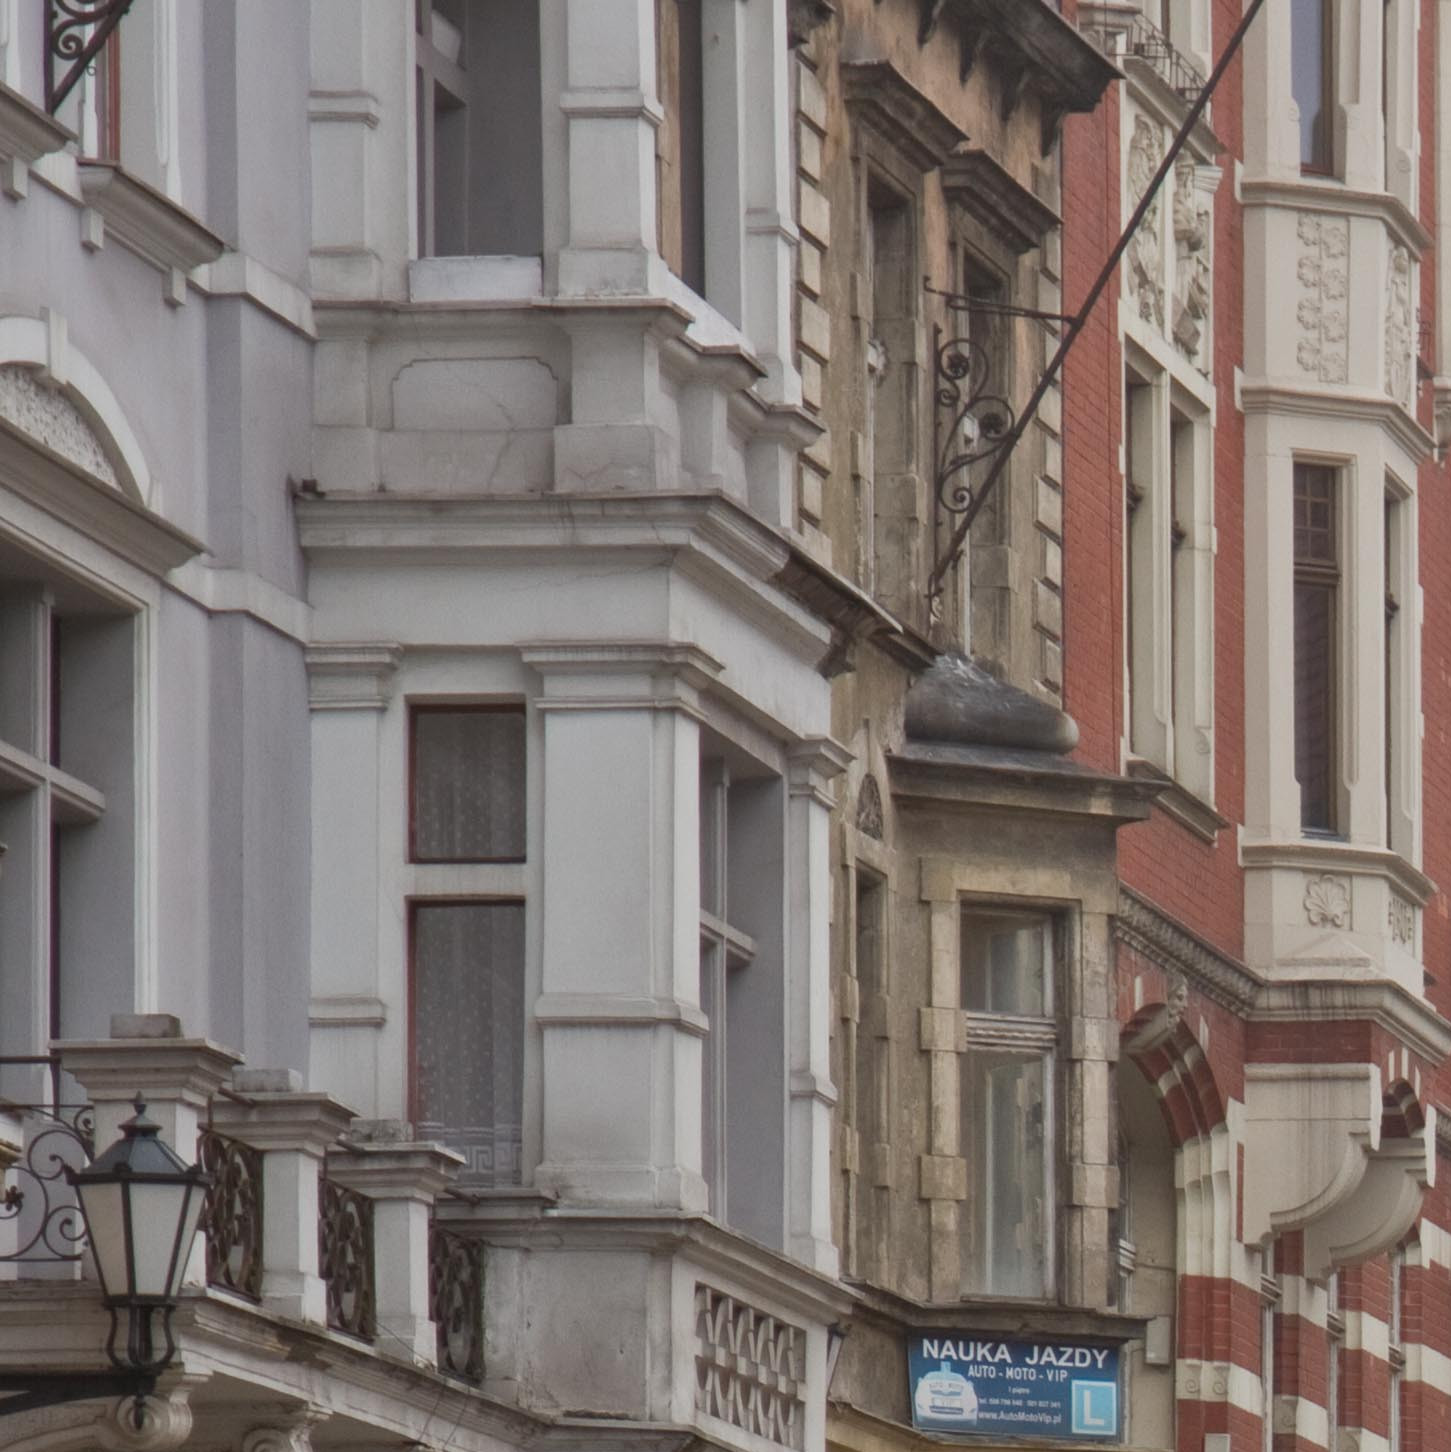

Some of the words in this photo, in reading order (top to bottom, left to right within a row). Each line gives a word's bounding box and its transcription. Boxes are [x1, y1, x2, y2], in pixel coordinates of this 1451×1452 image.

[922, 1338, 1013, 1364] NAUKA
[1025, 1345, 1109, 1369] JAZDY
[967, 1364, 996, 1379] AUTO
[1005, 1366, 1036, 1381] MOTO
[1046, 1369, 1068, 1383] VIP
[1083, 1389, 1105, 1427] L
